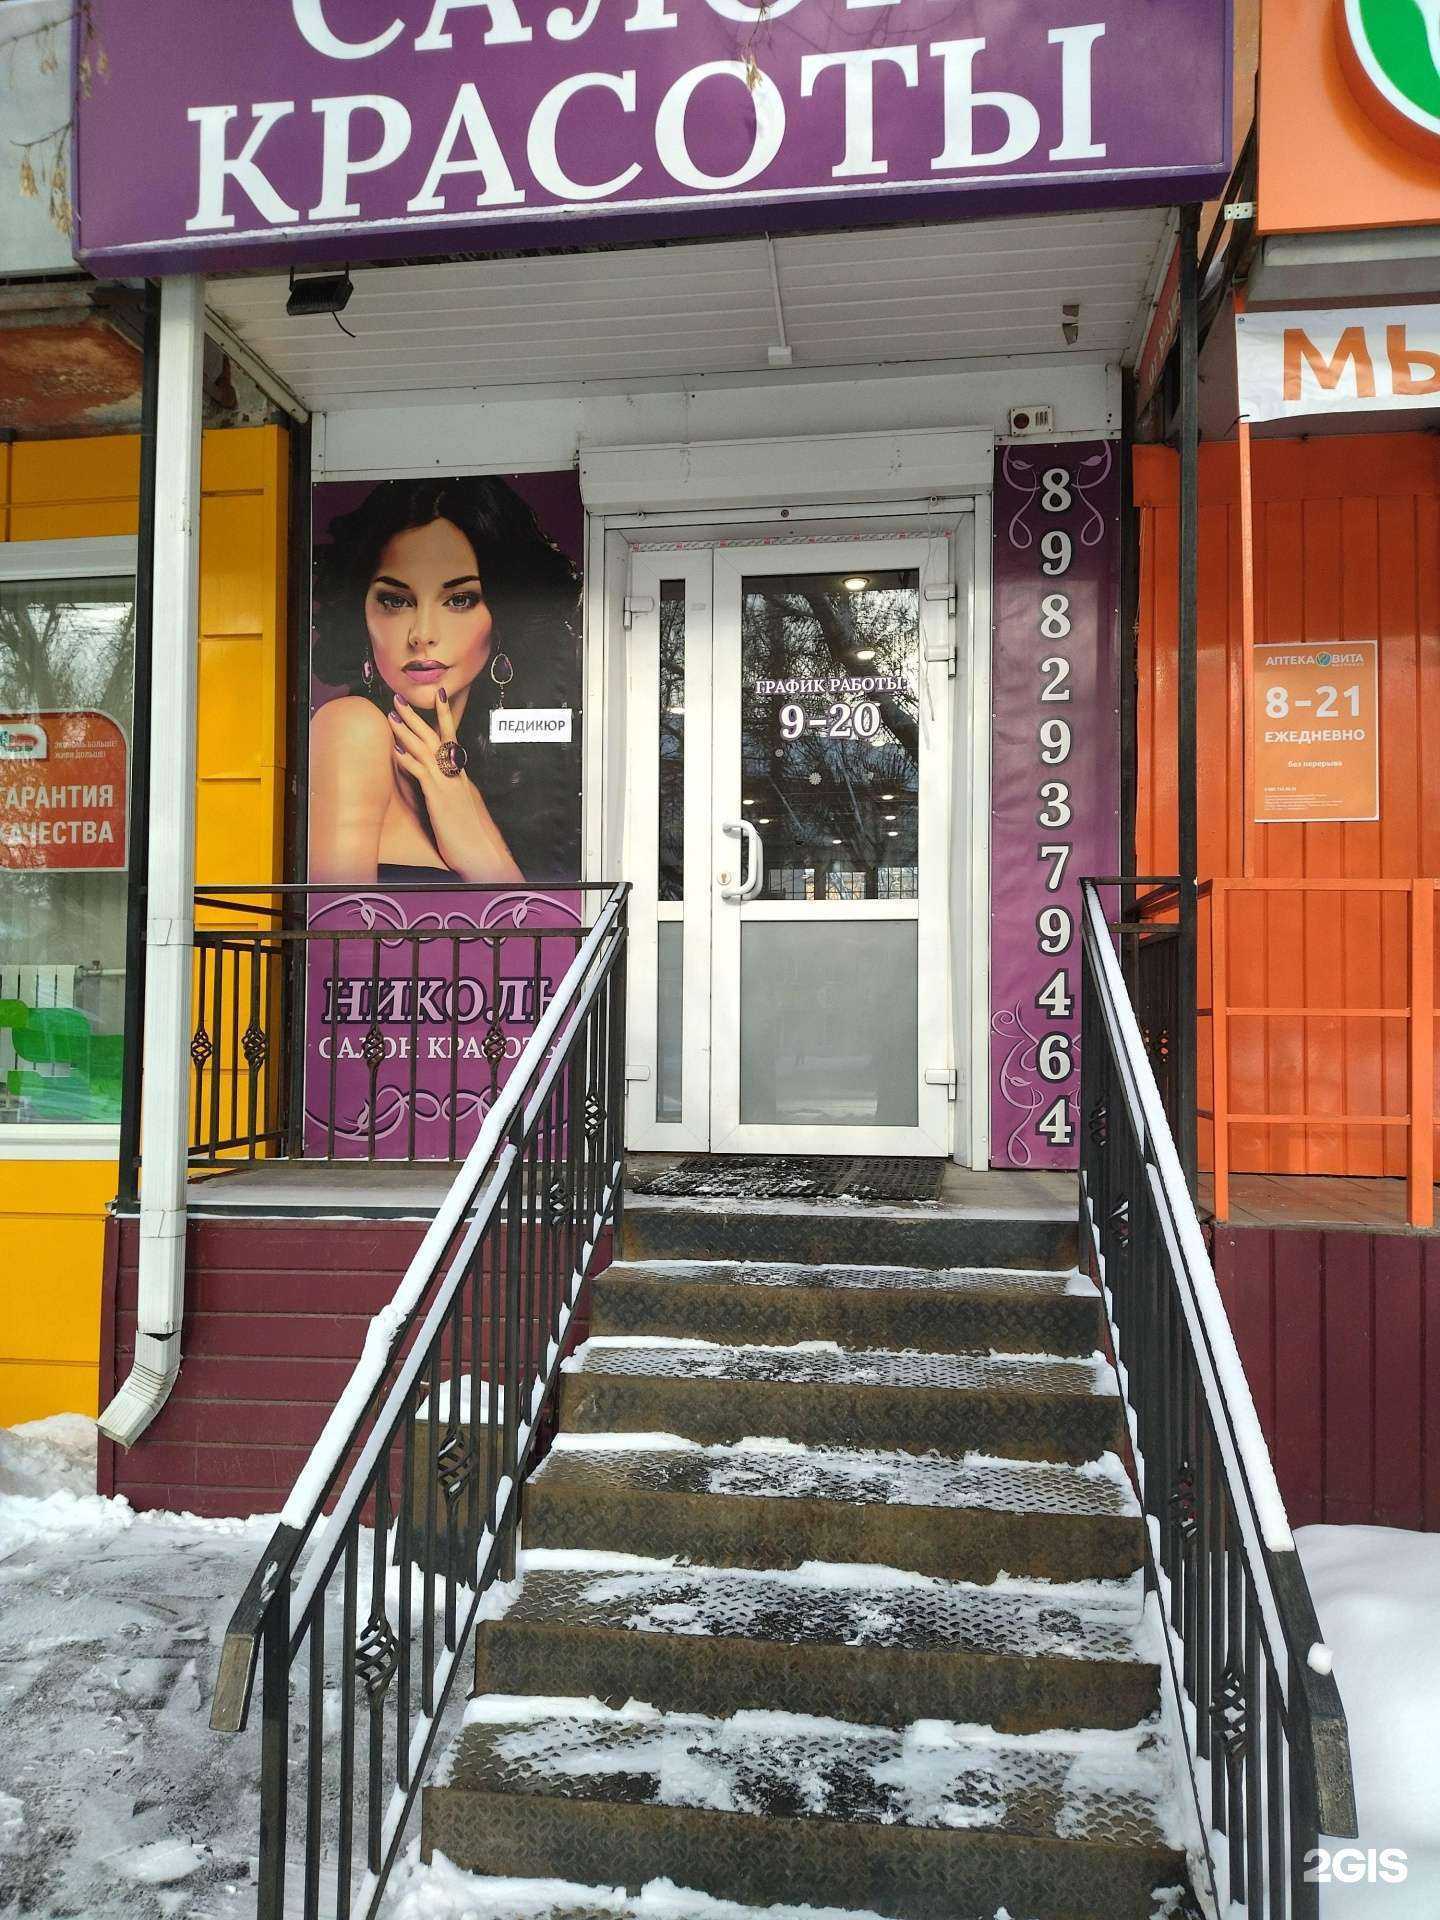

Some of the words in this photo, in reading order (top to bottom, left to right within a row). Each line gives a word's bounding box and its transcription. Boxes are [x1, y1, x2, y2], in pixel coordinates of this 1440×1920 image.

[185, 22, 1109, 232] КРАСОТЫ
[1265, 655, 1316, 666] АПТЕКА
[1332, 653, 1364, 664] ВИТА
[755, 680, 826, 694] ГРАФИК
[1265, 685, 1360, 718] 8-21
[498, 720, 566, 733] ПЕДИКЮР
[780, 702, 881, 740] 9-20
[1264, 728, 1366, 744] ЕЖЕДНЕВНО
[0, 820, 114, 846] АЧЕСТВА
